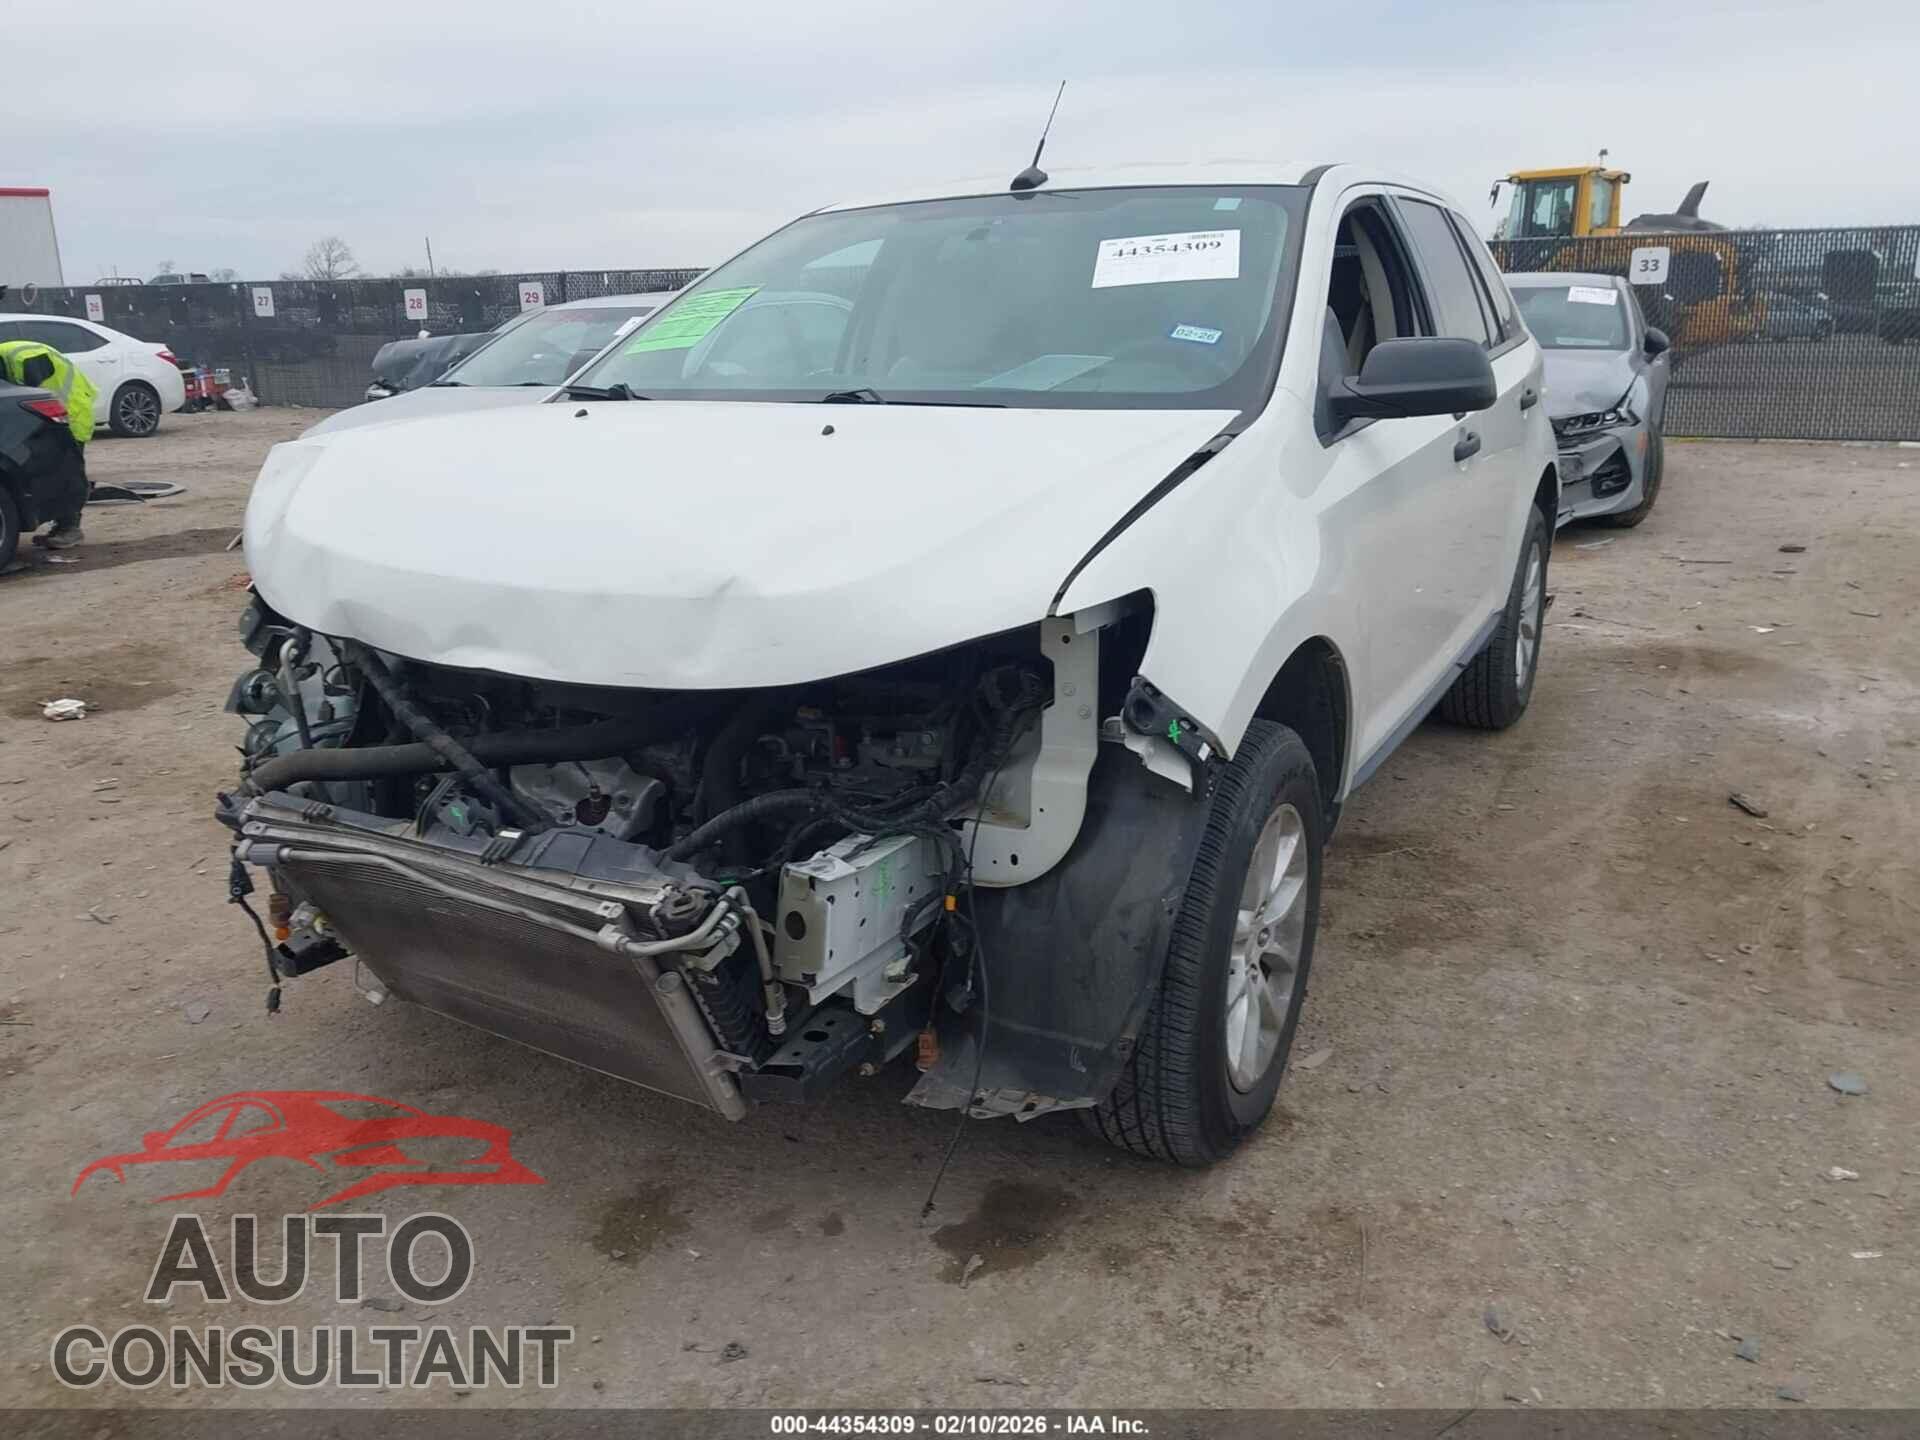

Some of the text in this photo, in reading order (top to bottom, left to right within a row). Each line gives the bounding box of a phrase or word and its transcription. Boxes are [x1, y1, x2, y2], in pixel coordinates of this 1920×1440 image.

[1112, 240, 1222, 258] 44354309
[1639, 259, 1660, 272] 33
[257, 296, 269, 306] 27
[409, 298, 423, 309] 28
[524, 292, 539, 304] 29
